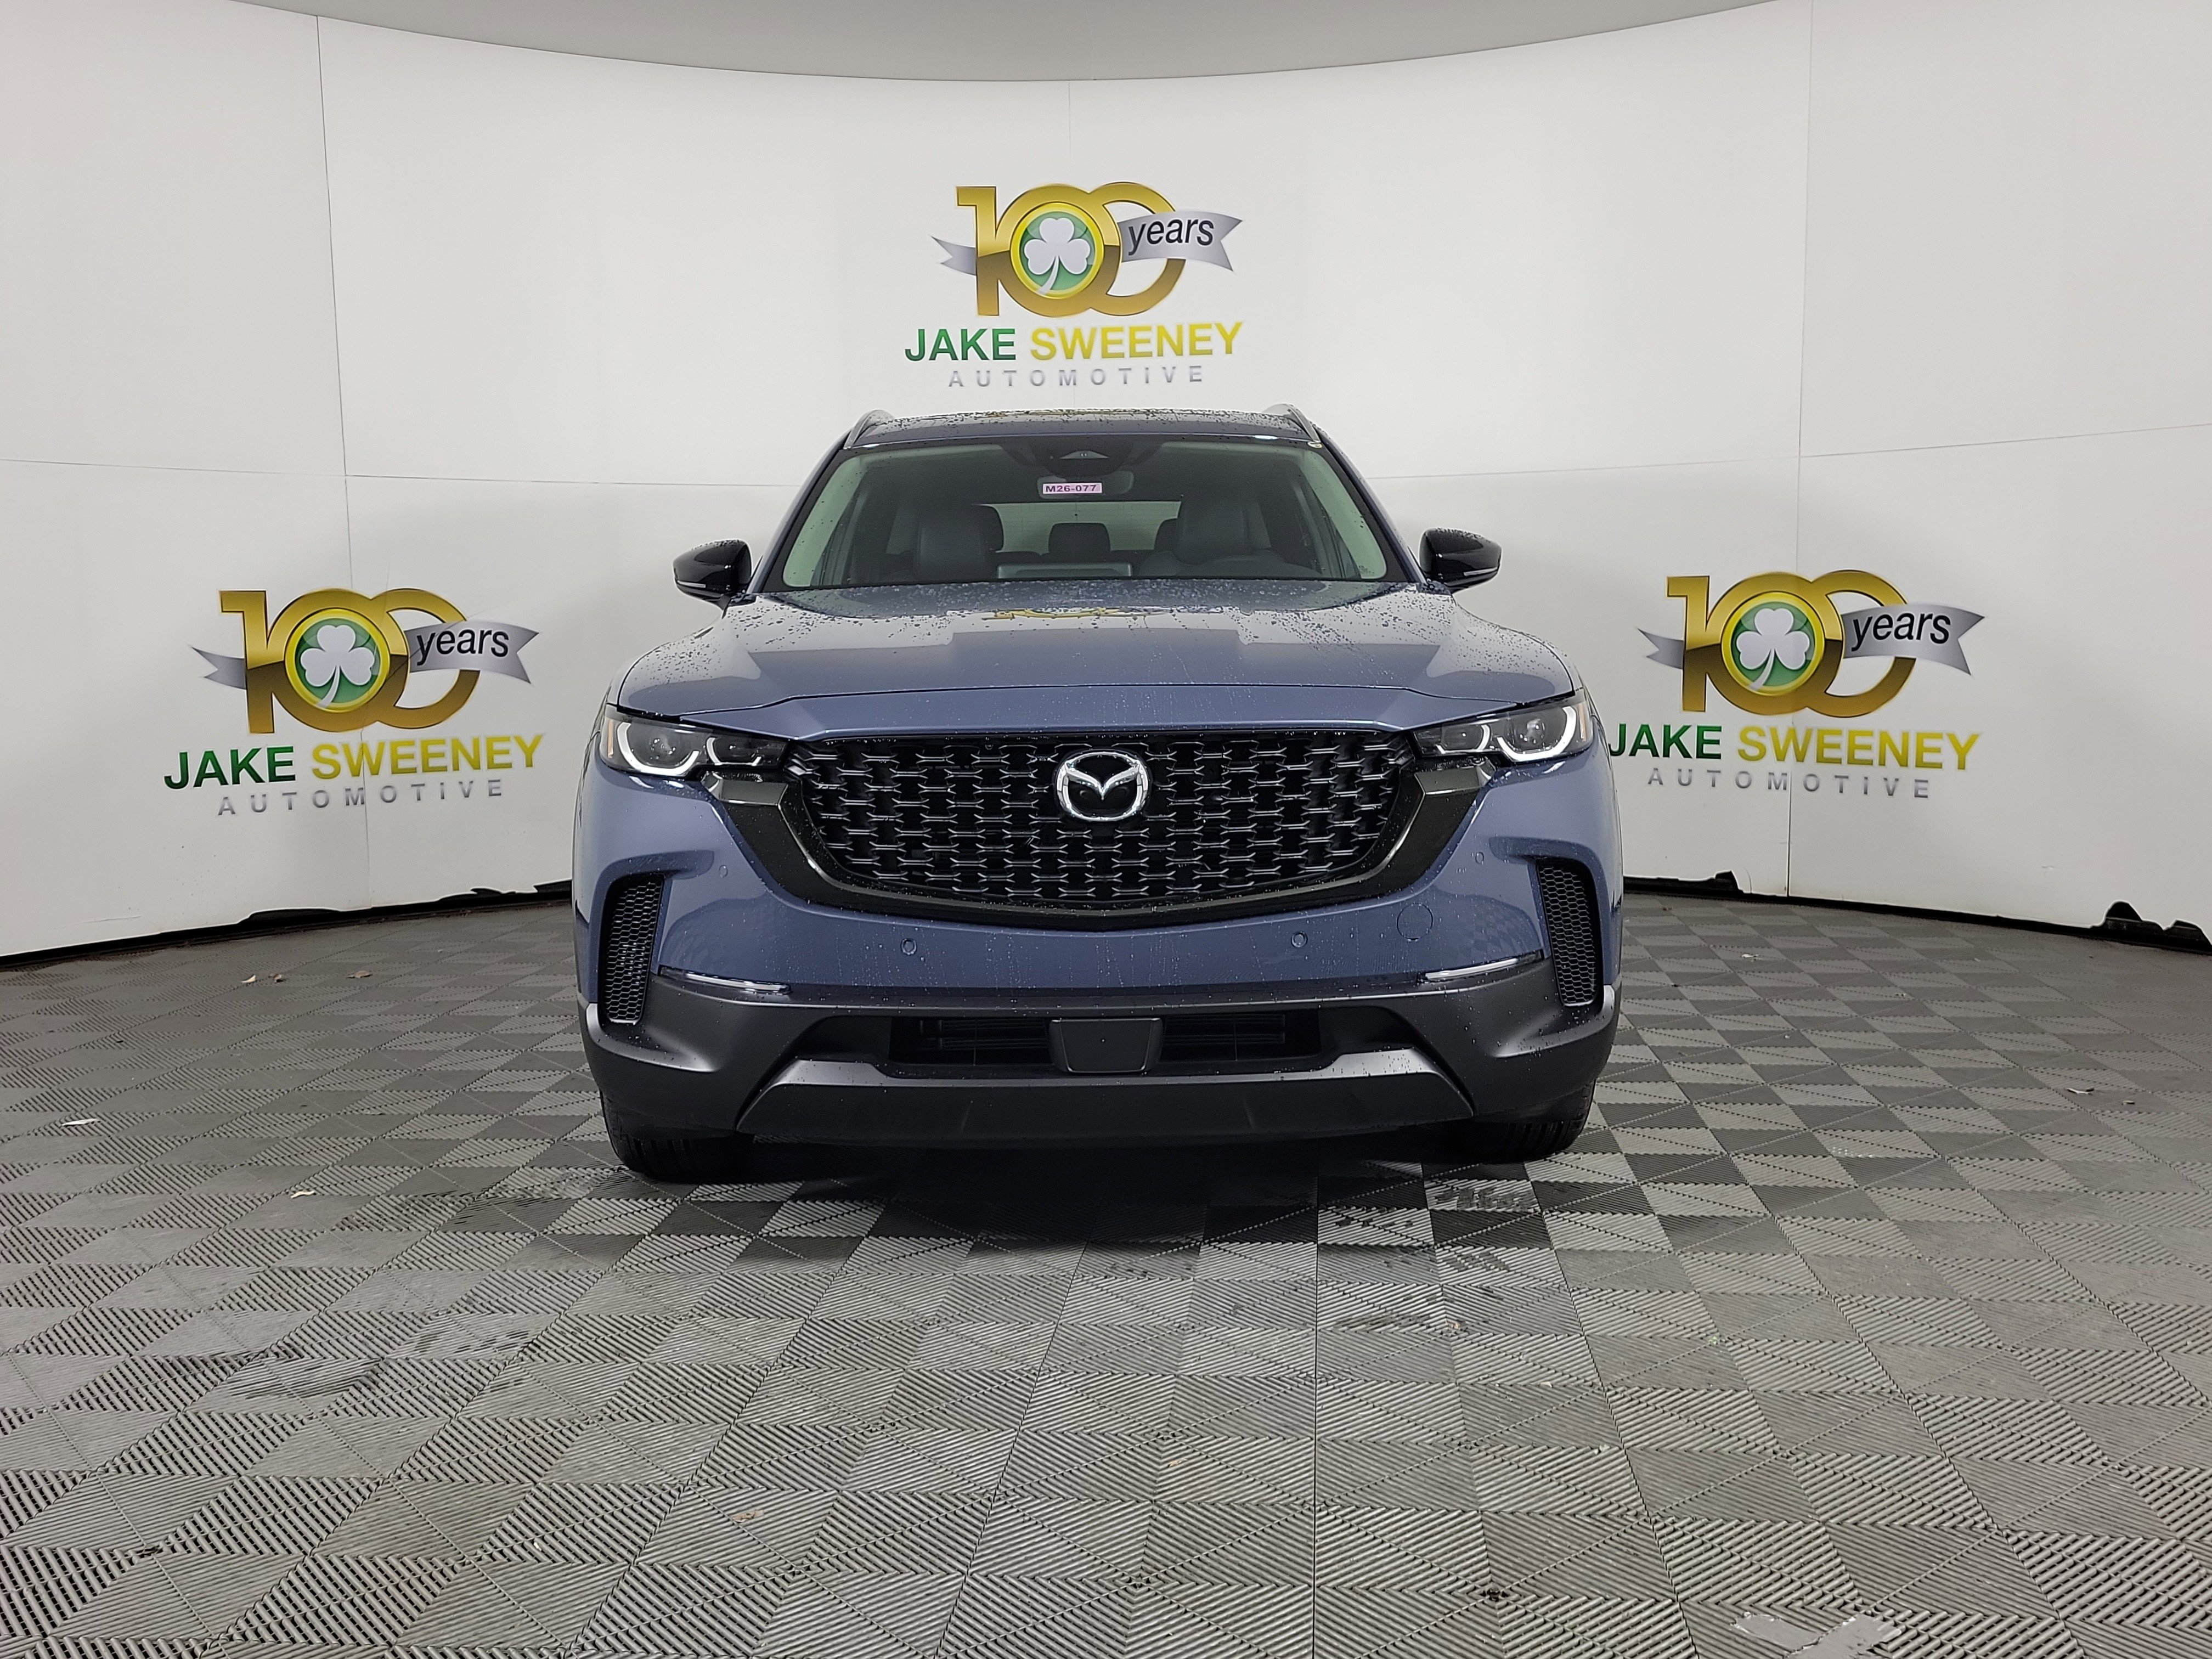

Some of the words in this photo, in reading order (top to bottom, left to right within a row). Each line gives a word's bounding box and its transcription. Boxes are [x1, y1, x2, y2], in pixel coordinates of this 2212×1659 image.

[956, 182, 1186, 317] 100
[1128, 218, 1214, 255] years
[905, 328, 1017, 361] JAKE
[1031, 321, 1243, 360] SWEENEY
[949, 366, 1203, 387] AUTOMOTIVE
[1046, 484, 1097, 493] M26-077
[218, 588, 480, 733] 100
[417, 629, 509, 666] years
[1667, 569, 1916, 718] 100
[1852, 612, 1950, 652] years
[164, 746, 296, 790] JAKE
[312, 735, 543, 779] SWEENEY
[1609, 723, 1722, 759] JAKE
[1737, 726, 1979, 770] SWEENEY
[217, 780, 502, 816] AUTOMOTIVE
[1648, 768, 1929, 798] AUTOMOTIVE
